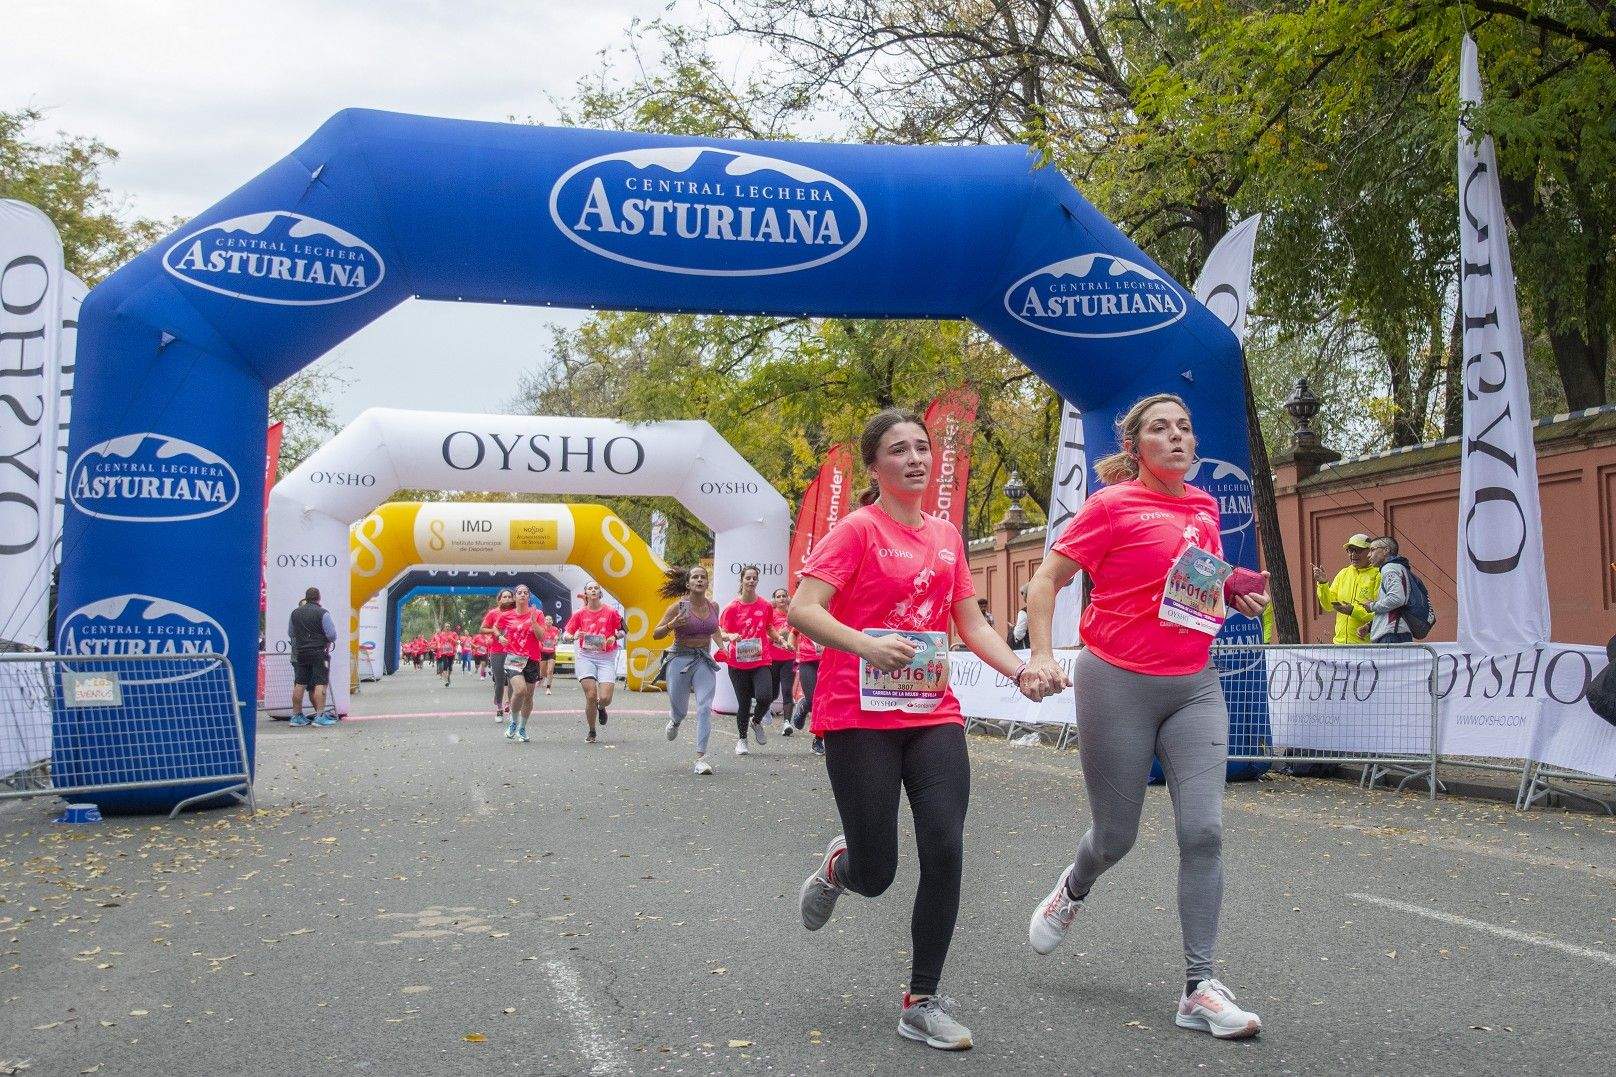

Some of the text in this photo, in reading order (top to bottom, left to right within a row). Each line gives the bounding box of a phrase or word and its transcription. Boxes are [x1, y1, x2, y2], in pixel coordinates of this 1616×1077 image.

[625, 177, 834, 202] CENTRAL LECHERA
[574, 177, 843, 245] ASTURIANA
[215, 237, 366, 262] CENTRAL LECHERA
[175, 240, 367, 288] ASTURIANA
[1049, 281, 1168, 293] CENTRAL LECHERA
[1020, 286, 1178, 318] ASTURIANA
[441, 430, 646, 475] OYSHO
[96, 463, 224, 477] CENTRAL LECHERA
[75, 465, 228, 503] ASTURIANA
[310, 471, 376, 487] OYSHO
[700, 480, 758, 495] OYSHO
[462, 520, 492, 533] IMD
[277, 554, 338, 569] OYSHO
[879, 548, 913, 559] OYSHO
[81, 625, 212, 636] CENTRAL LECHERA
[1268, 658, 1380, 702] OYSHO
[1428, 648, 1592, 705] OYSHO
[897, 683, 914, 691] 3807
[1455, 714, 1527, 728] WWW.OYSHO.COM
